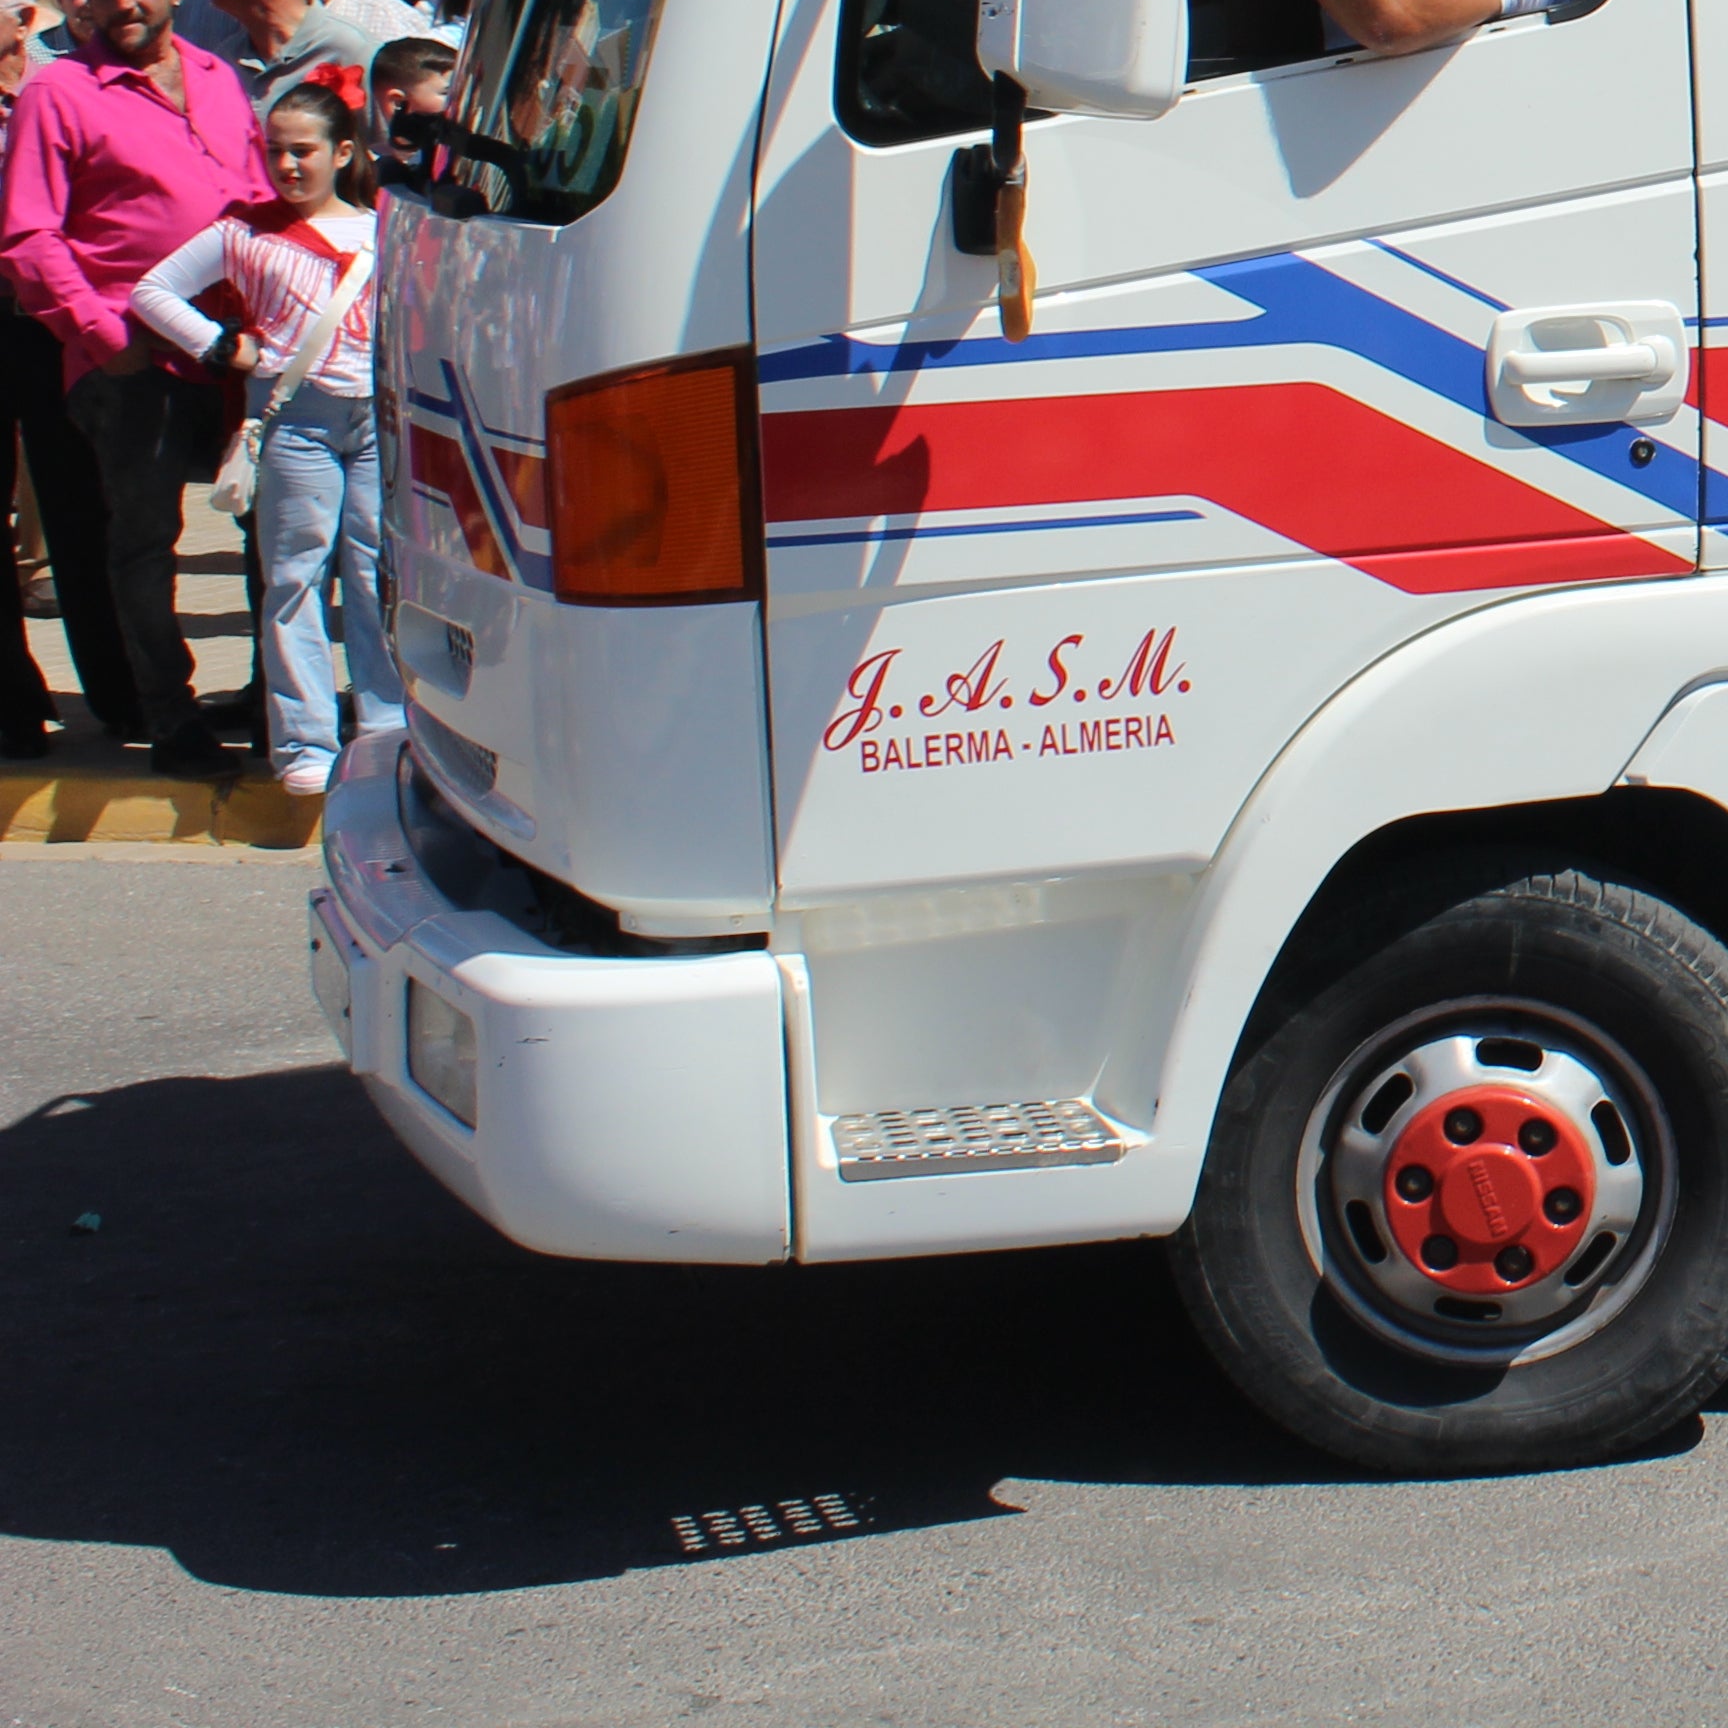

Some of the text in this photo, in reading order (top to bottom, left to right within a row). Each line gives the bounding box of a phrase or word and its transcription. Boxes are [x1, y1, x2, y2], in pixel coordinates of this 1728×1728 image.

[860, 728, 1013, 773] BALERMA
[1038, 714, 1176, 757] ALMERIA
[1468, 1158, 1508, 1238] NISSAN
